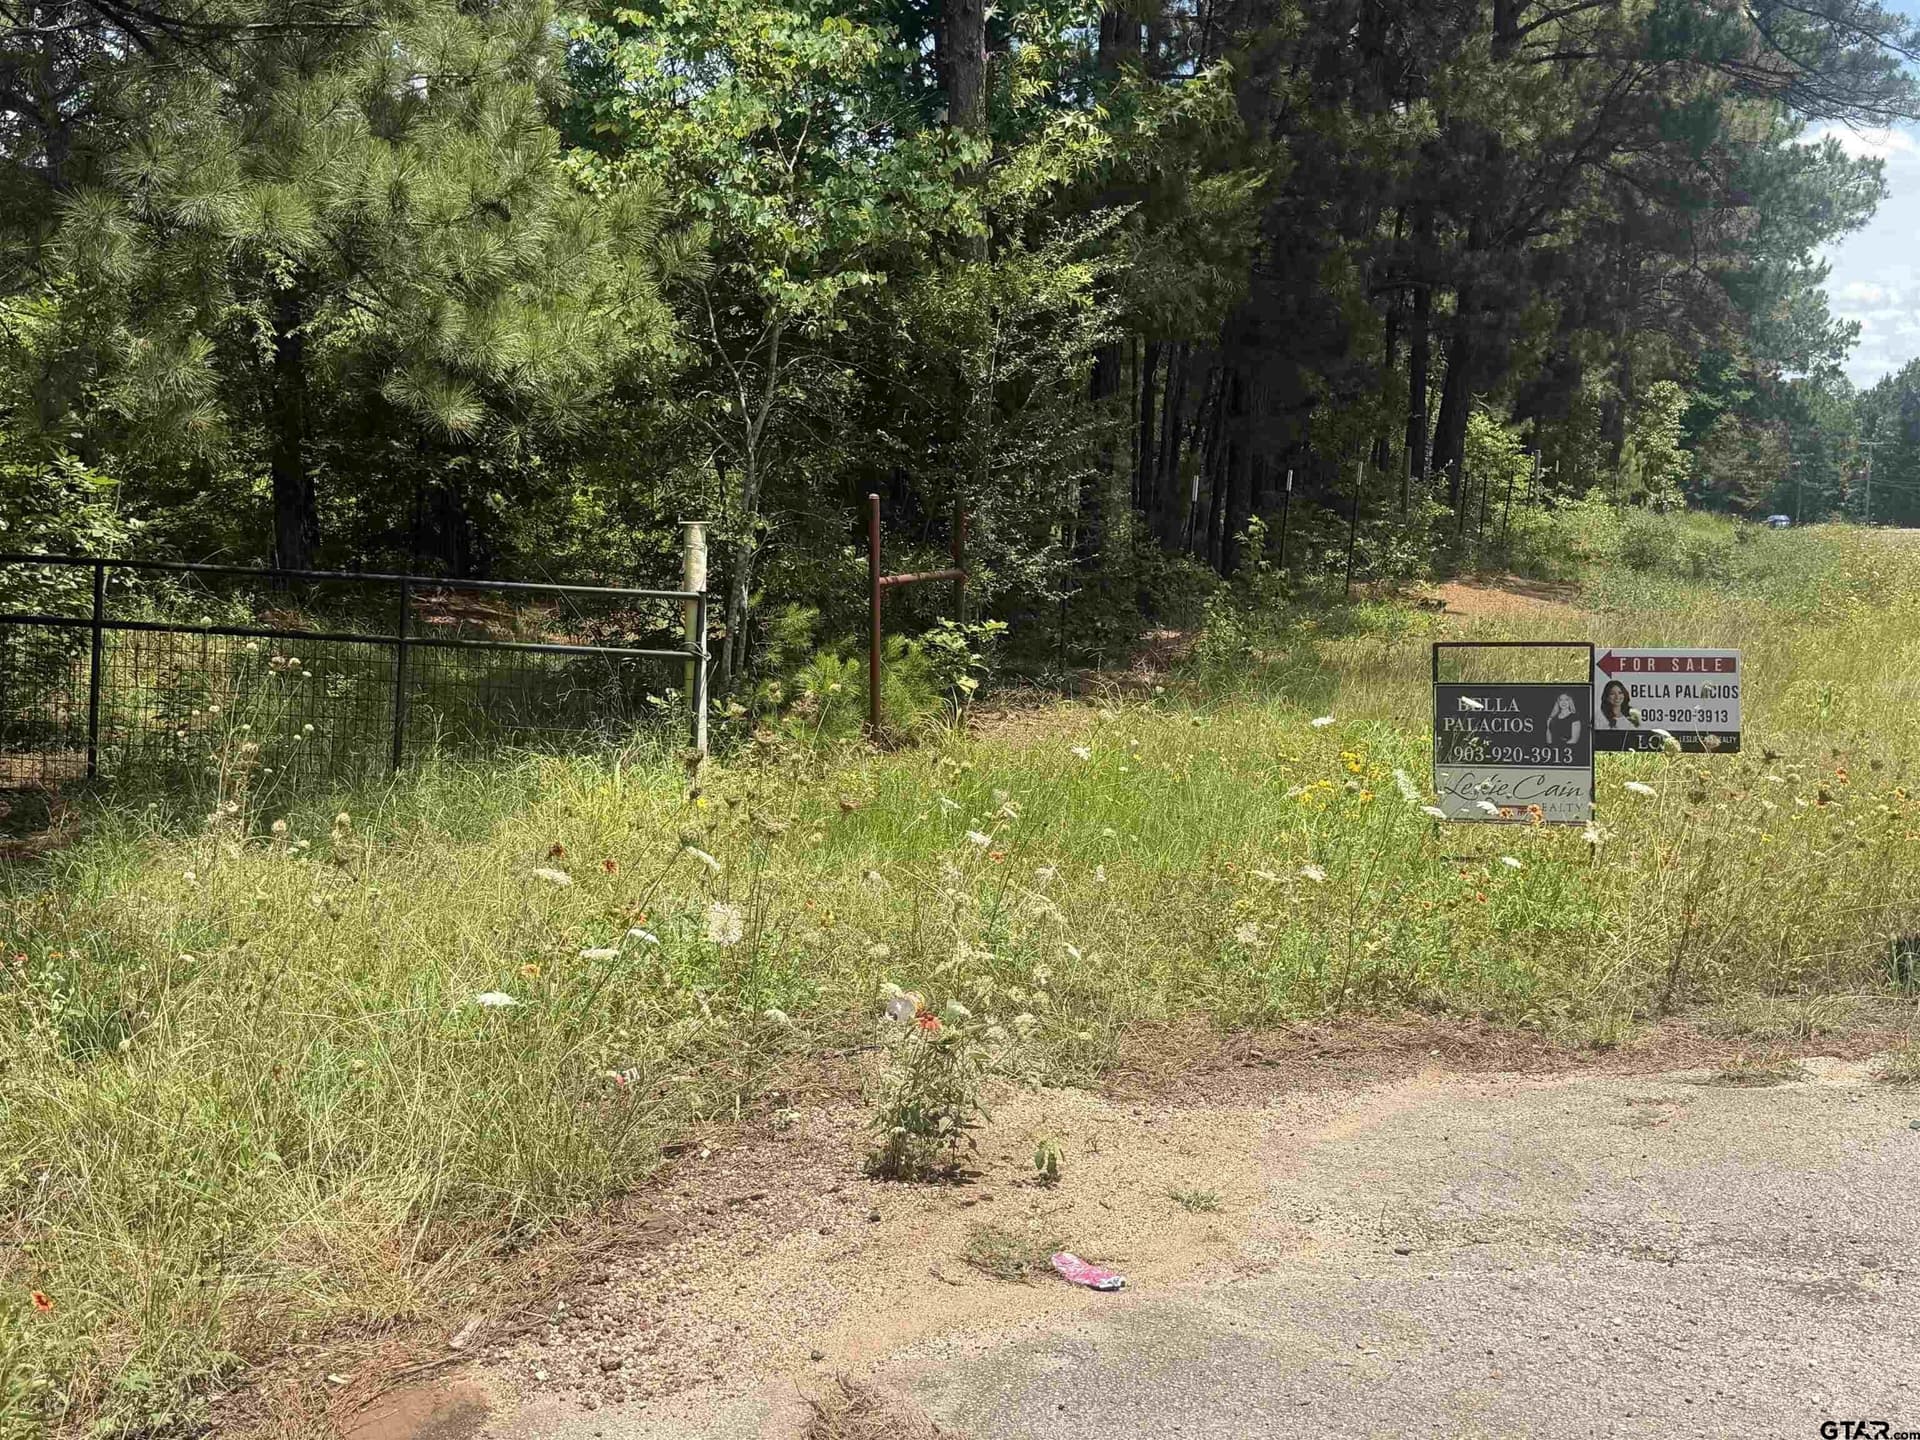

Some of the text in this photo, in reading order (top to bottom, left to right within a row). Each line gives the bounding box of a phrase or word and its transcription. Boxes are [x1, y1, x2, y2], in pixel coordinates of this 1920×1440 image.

[1620, 658, 1723, 672] FOR SALE
[1630, 685, 1671, 698] BELLA
[1457, 697, 1520, 712] BELLA
[1641, 709, 1729, 723] 903-920-3913
[1443, 717, 1534, 732] PALACIOS
[1454, 746, 1574, 764] 903-920-3913
[1513, 774, 1585, 800] Cain
[1541, 802, 1584, 812] EALTY
